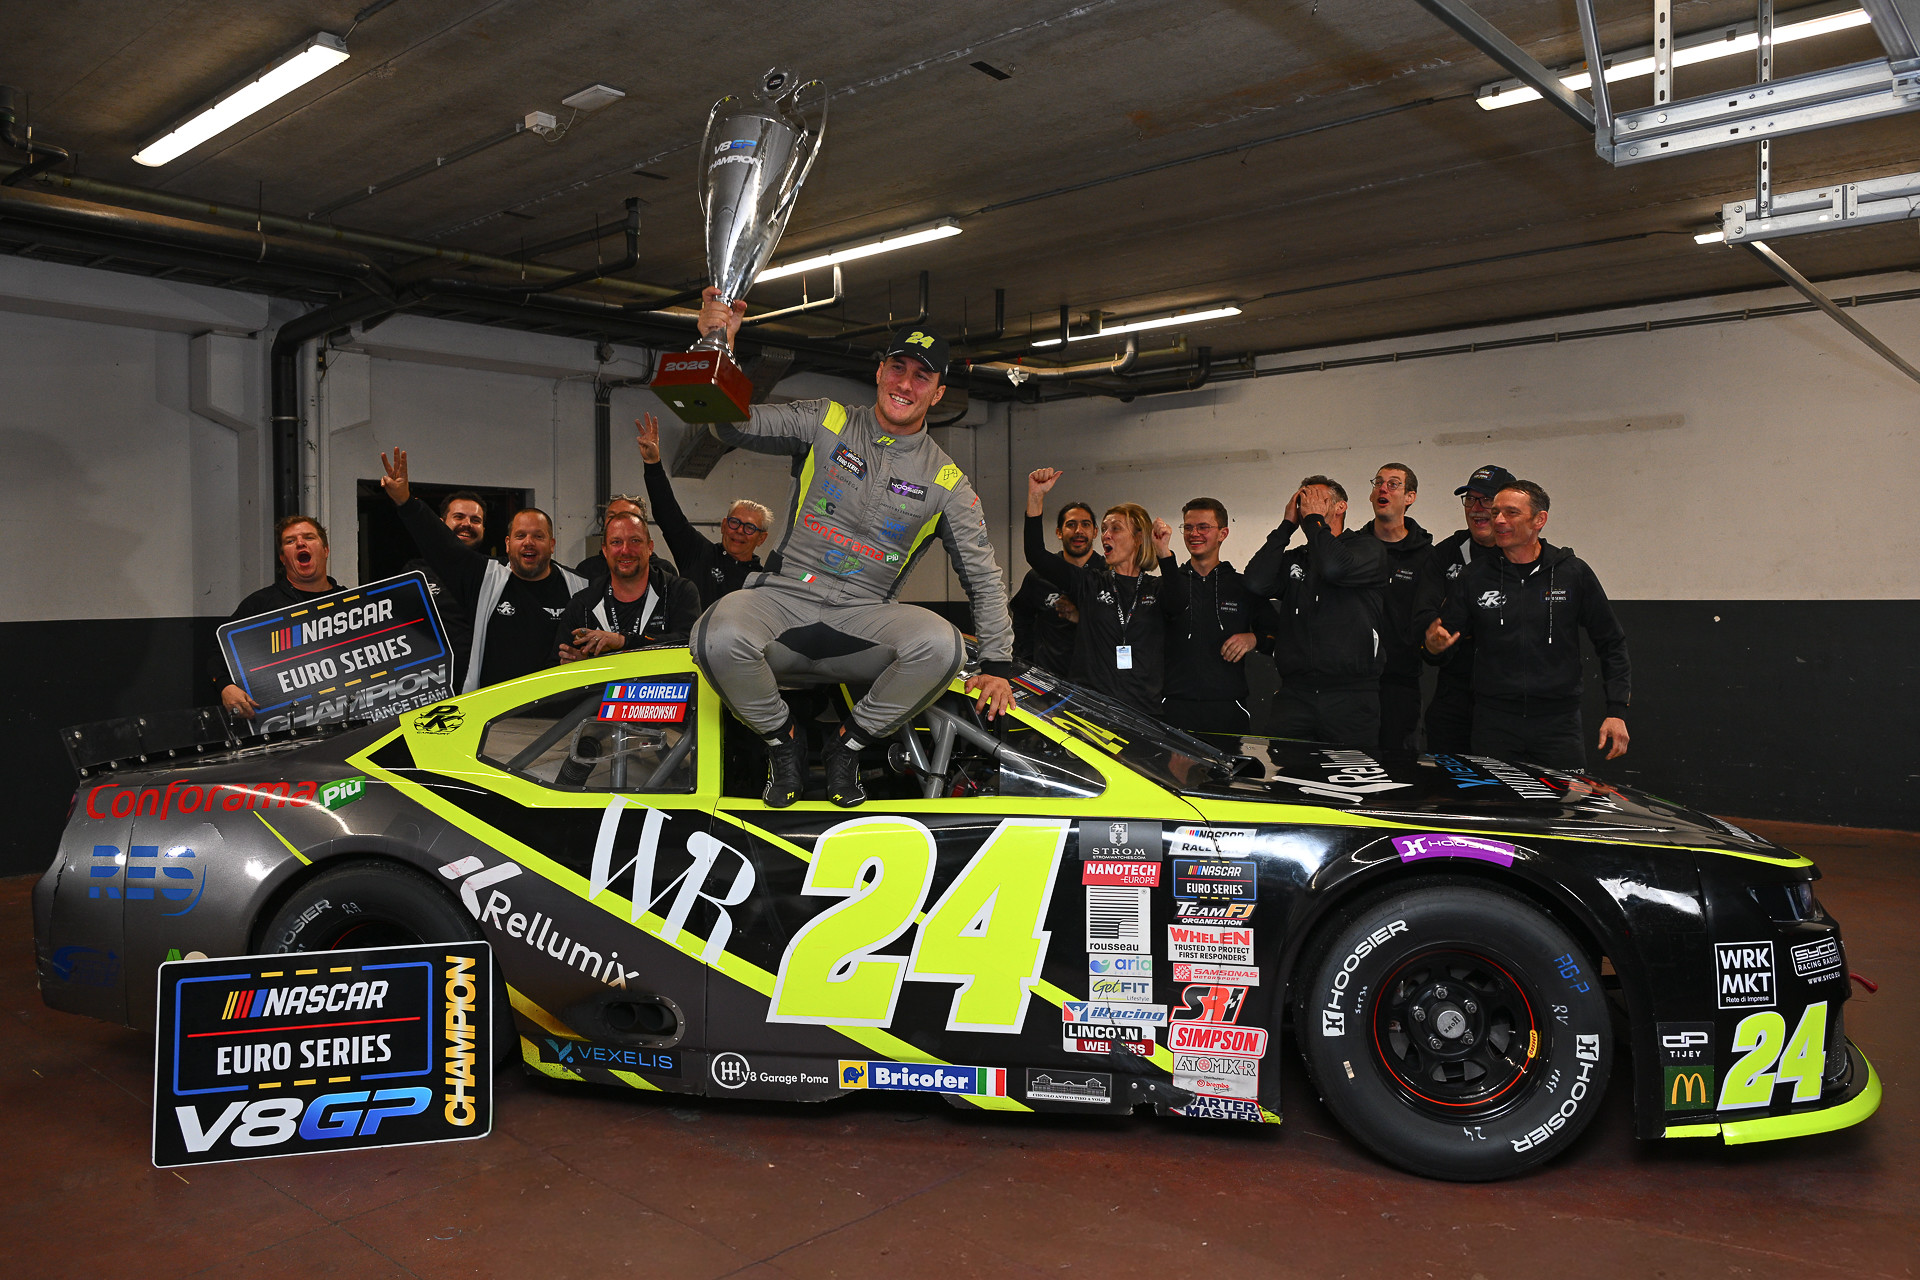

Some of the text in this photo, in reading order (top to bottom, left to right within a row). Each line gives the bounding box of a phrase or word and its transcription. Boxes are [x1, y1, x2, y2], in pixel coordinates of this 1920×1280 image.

[715, 140, 757, 154] V8GP
[905, 331, 935, 349] 24
[664, 360, 710, 371] 2026
[804, 514, 884, 560] Conforama
[302, 599, 394, 645] NASCAR
[277, 635, 412, 693] EURO SERIES
[260, 664, 446, 734] CHAMPION
[410, 687, 449, 707] TEAM
[627, 686, 689, 699] V. GHIRELLI
[621, 705, 678, 719] T. DOMBROWSKI
[86, 779, 362, 820] Conforama Più
[88, 845, 196, 900] RES
[1087, 863, 1156, 876] NANOTECH
[1201, 866, 1242, 877] NASCAR
[1186, 883, 1243, 895] EURO SERIES
[766, 815, 1072, 1035] 24
[1181, 918, 1242, 926] ORGANIZATION
[481, 890, 640, 991] Rellumix
[1169, 926, 1250, 945] WHELEN
[1089, 943, 1139, 951] rousseau
[1174, 944, 1206, 952] TRUSTED
[1217, 946, 1250, 954] PROTECT
[1179, 951, 1247, 961] FIRST RESPONDERS
[1795, 942, 1836, 961] SYCO
[1115, 956, 1151, 970] aria
[1327, 919, 1409, 1010] HOOSIER
[1719, 947, 1770, 969] WRK
[1797, 954, 1840, 971] RACING RADIOS
[1194, 968, 1258, 978] SAMSONAS
[1807, 972, 1840, 984] WWW.SYCO.EU
[1722, 972, 1771, 994] MKT
[263, 980, 389, 1017] NASCAR
[1747, 995, 1769, 1003] Imprese
[1090, 1007, 1165, 1021] iRacing
[445, 955, 476, 1127] CHAMPION
[1084, 1040, 1146, 1055] WELRS
[1175, 1027, 1259, 1052] SIMPSON
[217, 1034, 392, 1076] EURO SERIES
[577, 1045, 673, 1069] VEXELIS
[1670, 1050, 1701, 1058] TIJEY
[1716, 1000, 1828, 1111] 24
[1176, 1055, 1256, 1077] ATOMIX-R
[741, 1071, 829, 1084] V8 Garage Poma
[875, 1067, 968, 1089] Bricofer
[1206, 1081, 1229, 1089] brembo
[1185, 1106, 1260, 1121] MASTER
[1190, 1097, 1256, 1113] ARTER
[1510, 1061, 1594, 1153] HOOSIER
[174, 1087, 432, 1153] V8GP
[1463, 1126, 1486, 1141] 24
